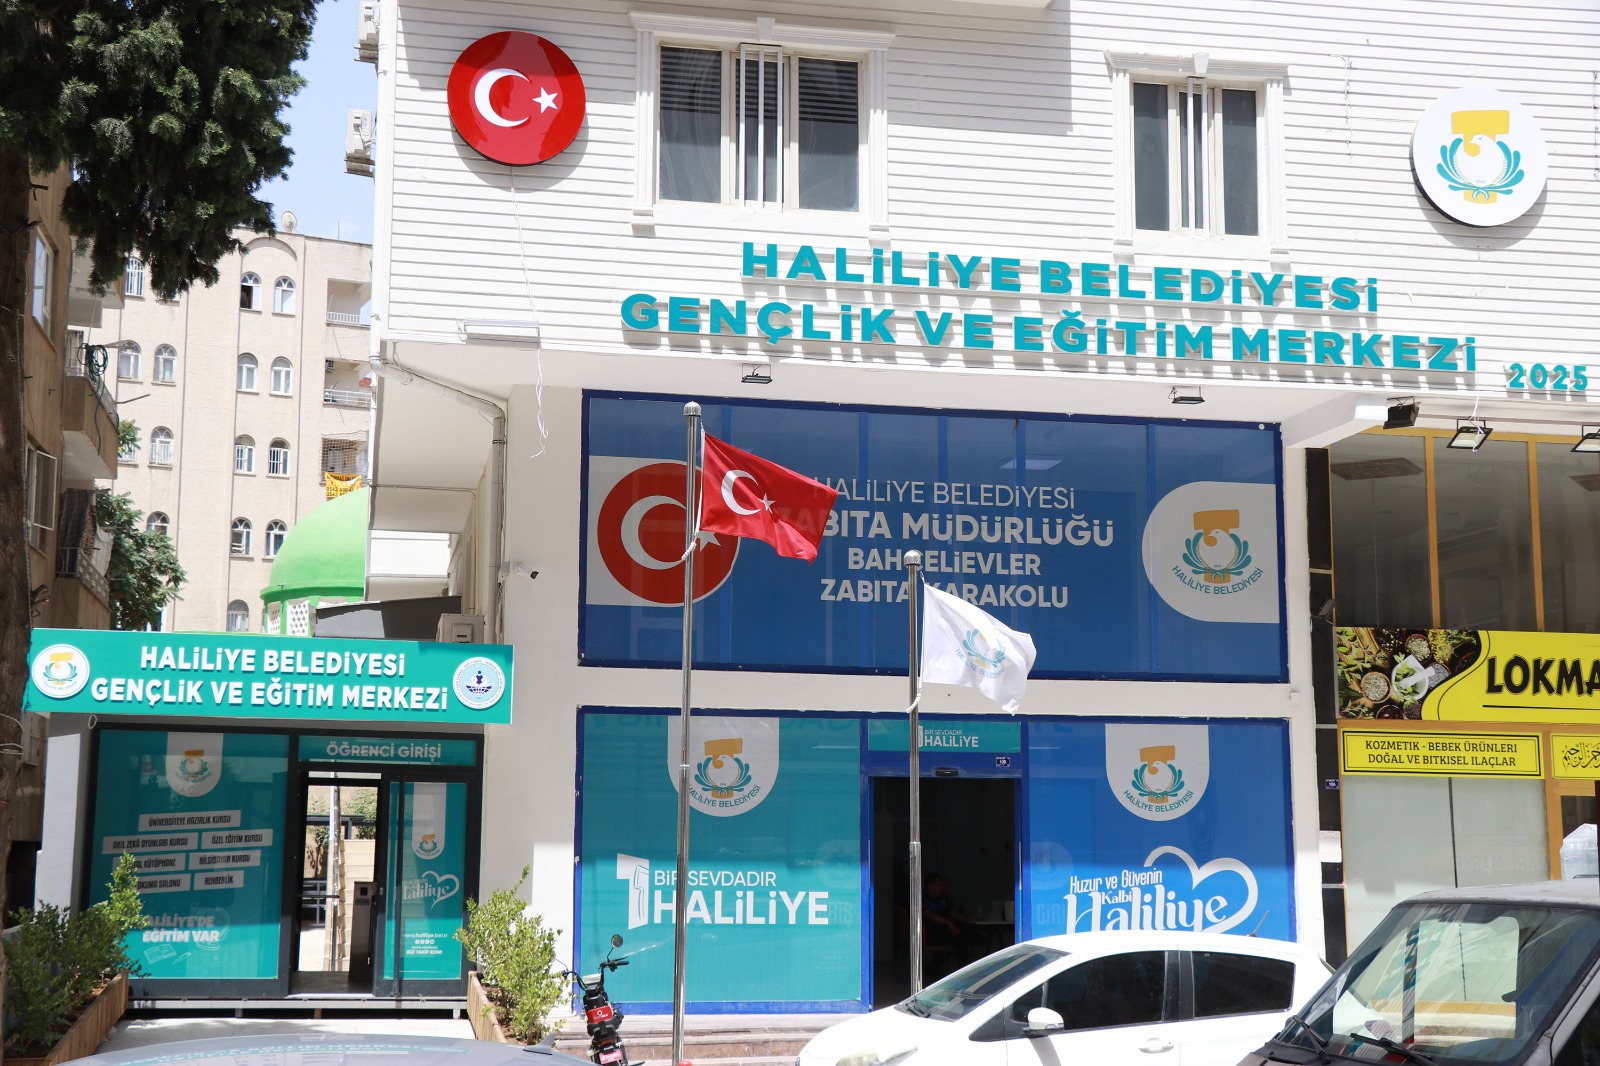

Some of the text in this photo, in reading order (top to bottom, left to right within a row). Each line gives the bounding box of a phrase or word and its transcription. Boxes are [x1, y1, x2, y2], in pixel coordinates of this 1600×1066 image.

[915, 312, 995, 348] VE
[1508, 362, 1588, 392] 2025
[902, 512, 1114, 547] MÜDÜRLÜĞÜ
[848, 547, 1041, 576] BAHELİEVLER
[820, 578, 1069, 609] ZABITA ARAKOLU
[210, 681, 242, 704] VE
[326, 741, 441, 760] ÖĞRENCİ GİRİŞİ
[1428, 742, 1462, 752] BEBEK
[1368, 753, 1405, 764] DOĞAL
[1407, 754, 1420, 764] VE
[187, 815, 211, 826] HAZIRLIK
[212, 814, 231, 825] KURSU
[169, 837, 189, 847] KURSU
[211, 834, 223, 844] ÖZEL
[244, 834, 263, 843] KURSU
[143, 857, 176, 868] KÜTÜPHANE
[232, 854, 251, 863] KURSU
[159, 878, 181, 888] SALONU
[688, 870, 777, 887] SEVDADIR
[1070, 867, 1163, 895] Huzur ve Güvenin
[1101, 889, 1134, 905] Kalbi
[148, 913, 215, 929] ALİLİYE'DE
[191, 930, 221, 943] VAR
